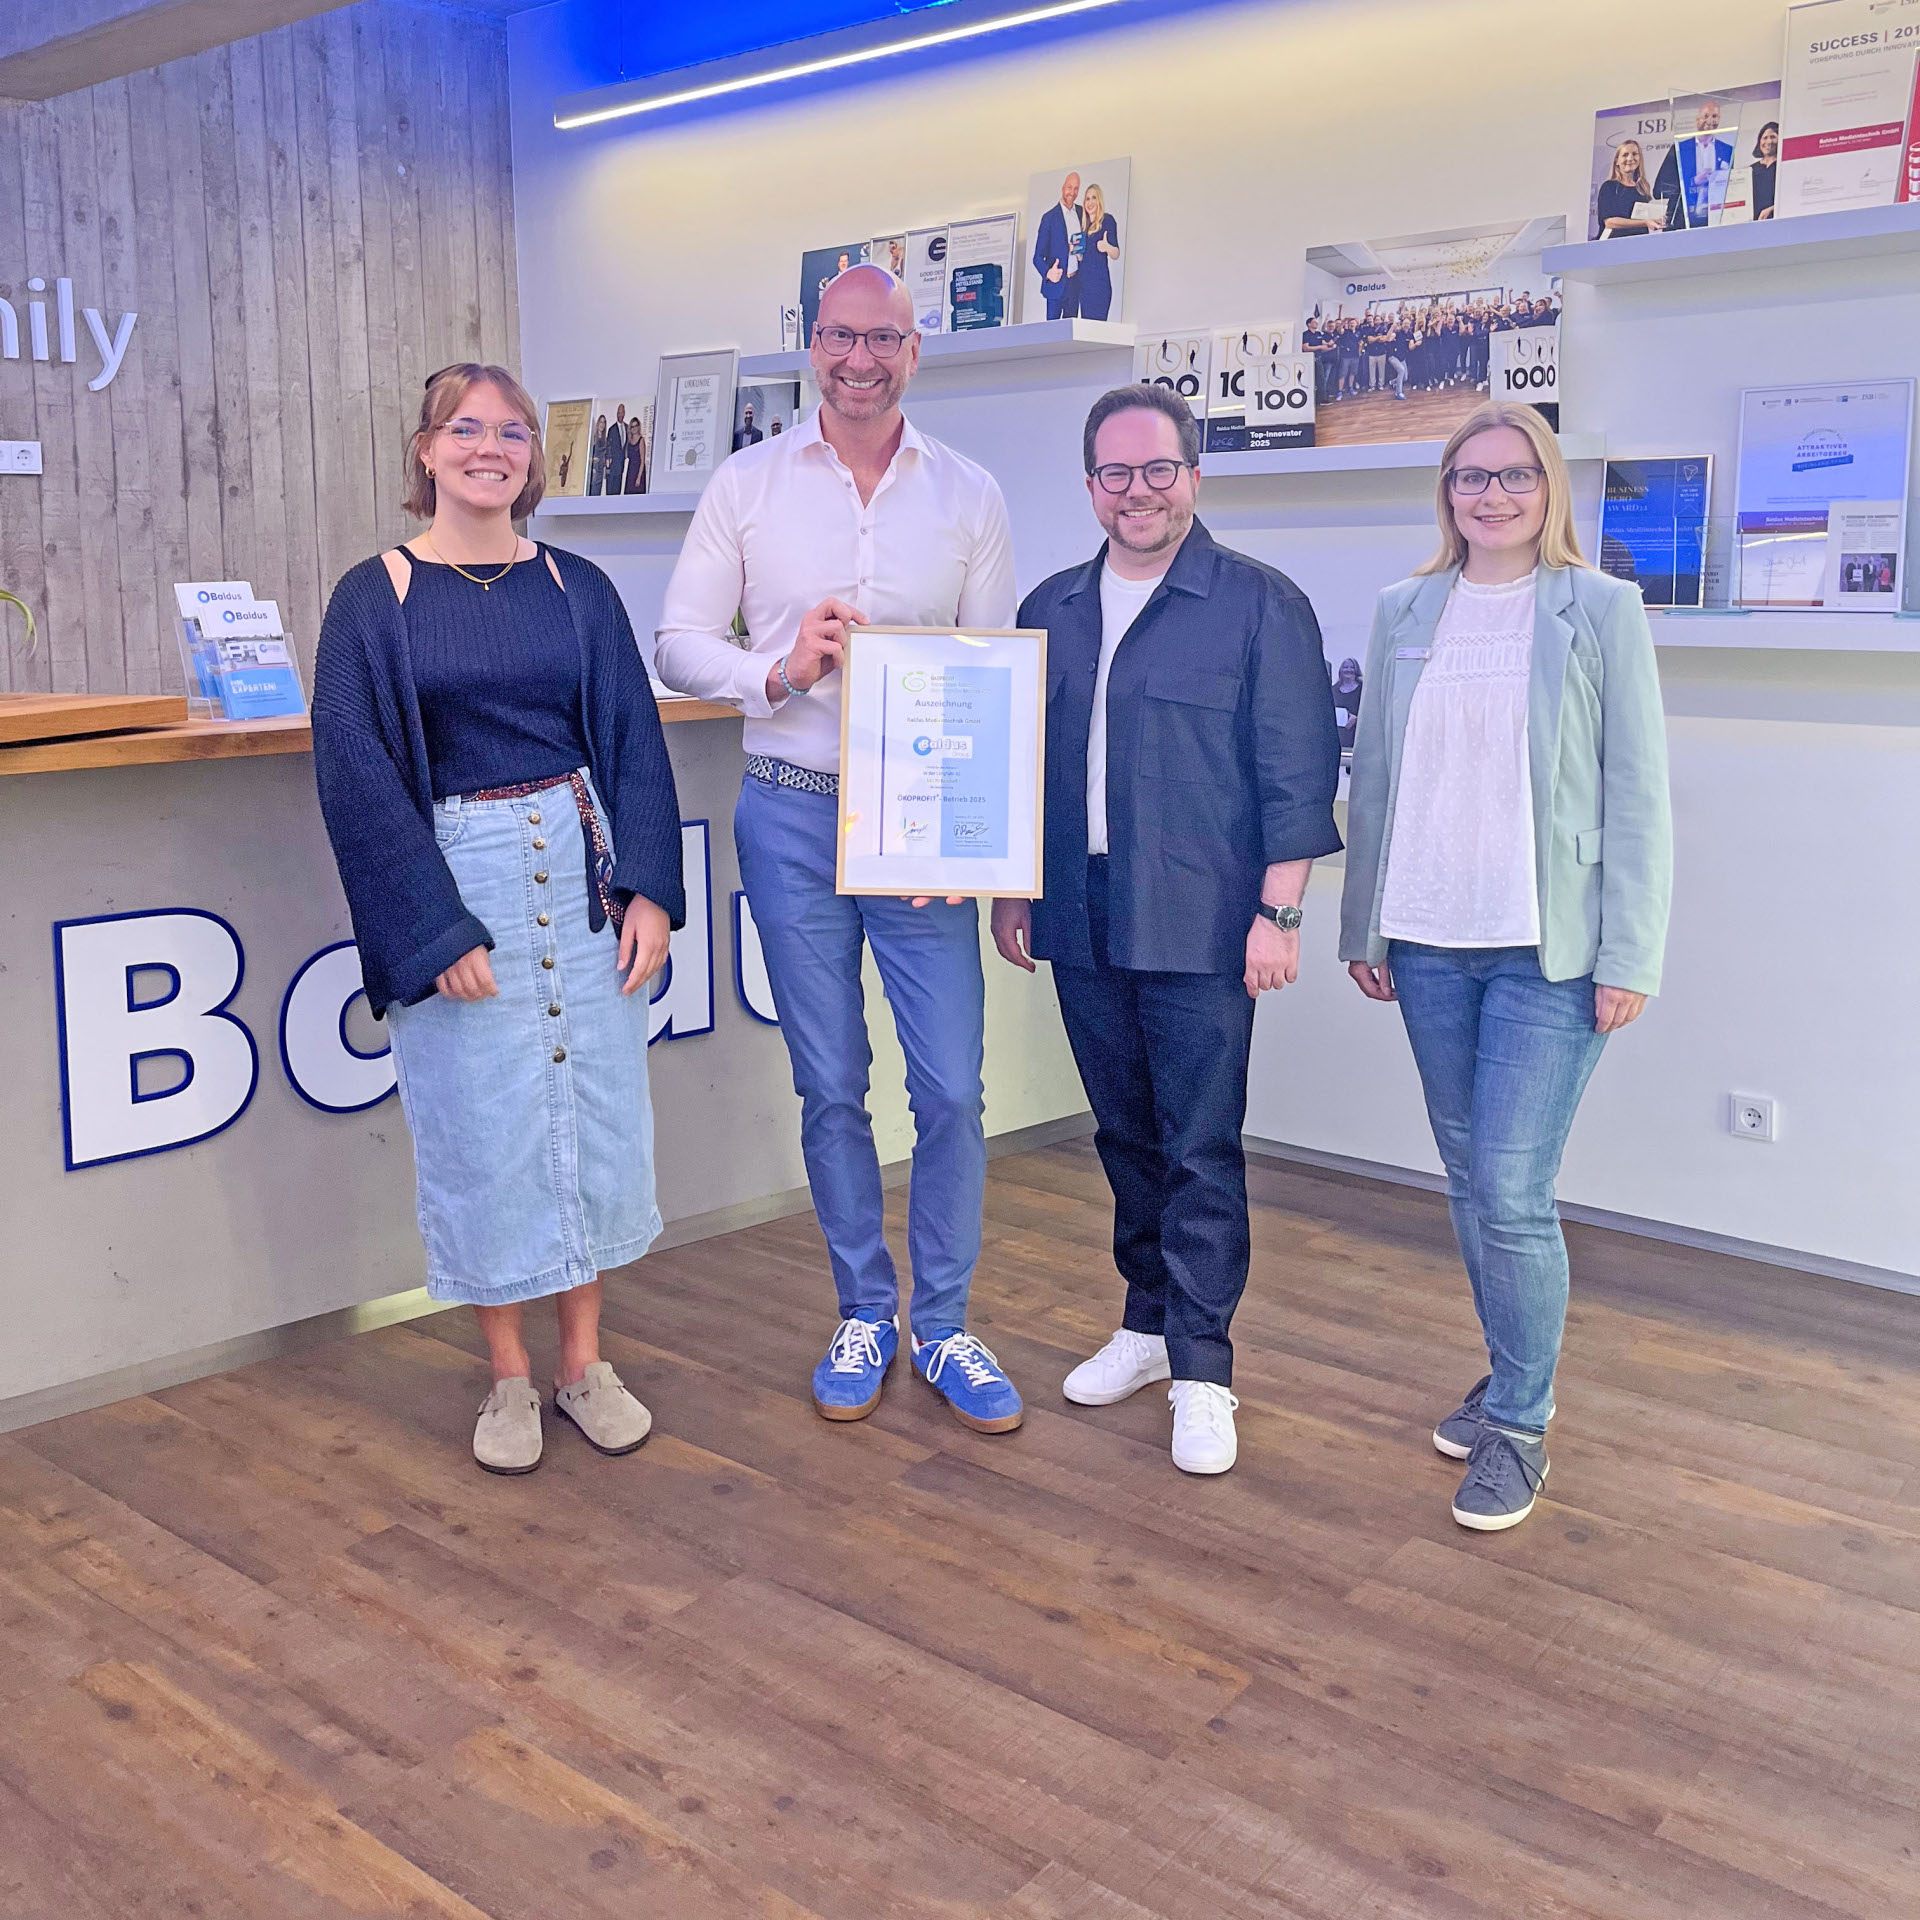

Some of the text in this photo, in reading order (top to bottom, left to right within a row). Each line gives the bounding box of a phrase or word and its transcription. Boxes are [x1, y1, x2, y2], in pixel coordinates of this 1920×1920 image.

[1809, 32, 1879, 54] SUCCESS
[1809, 51, 1854, 64] VORSPRUNG
[1855, 47, 1882, 57] DURCH
[1637, 118, 1667, 135] ISB
[1356, 283, 1386, 293] Baldus
[684, 377, 711, 389] URKUNDE
[1220, 369, 1246, 398] 10
[1254, 388, 1308, 411] 100
[1249, 429, 1302, 439] Top-Innovator
[1249, 440, 1271, 448] 2025
[1797, 443, 1848, 451] ATTRAKTIVER
[1796, 450, 1848, 458] ARBEITGEBER
[1607, 485, 1649, 494] BUSINESS
[1605, 495, 1633, 503] HERO
[210, 592, 242, 601] Baldus
[235, 610, 268, 621] Baldus
[914, 699, 973, 710] Auszeichnung
[921, 739, 967, 750] Baldus
